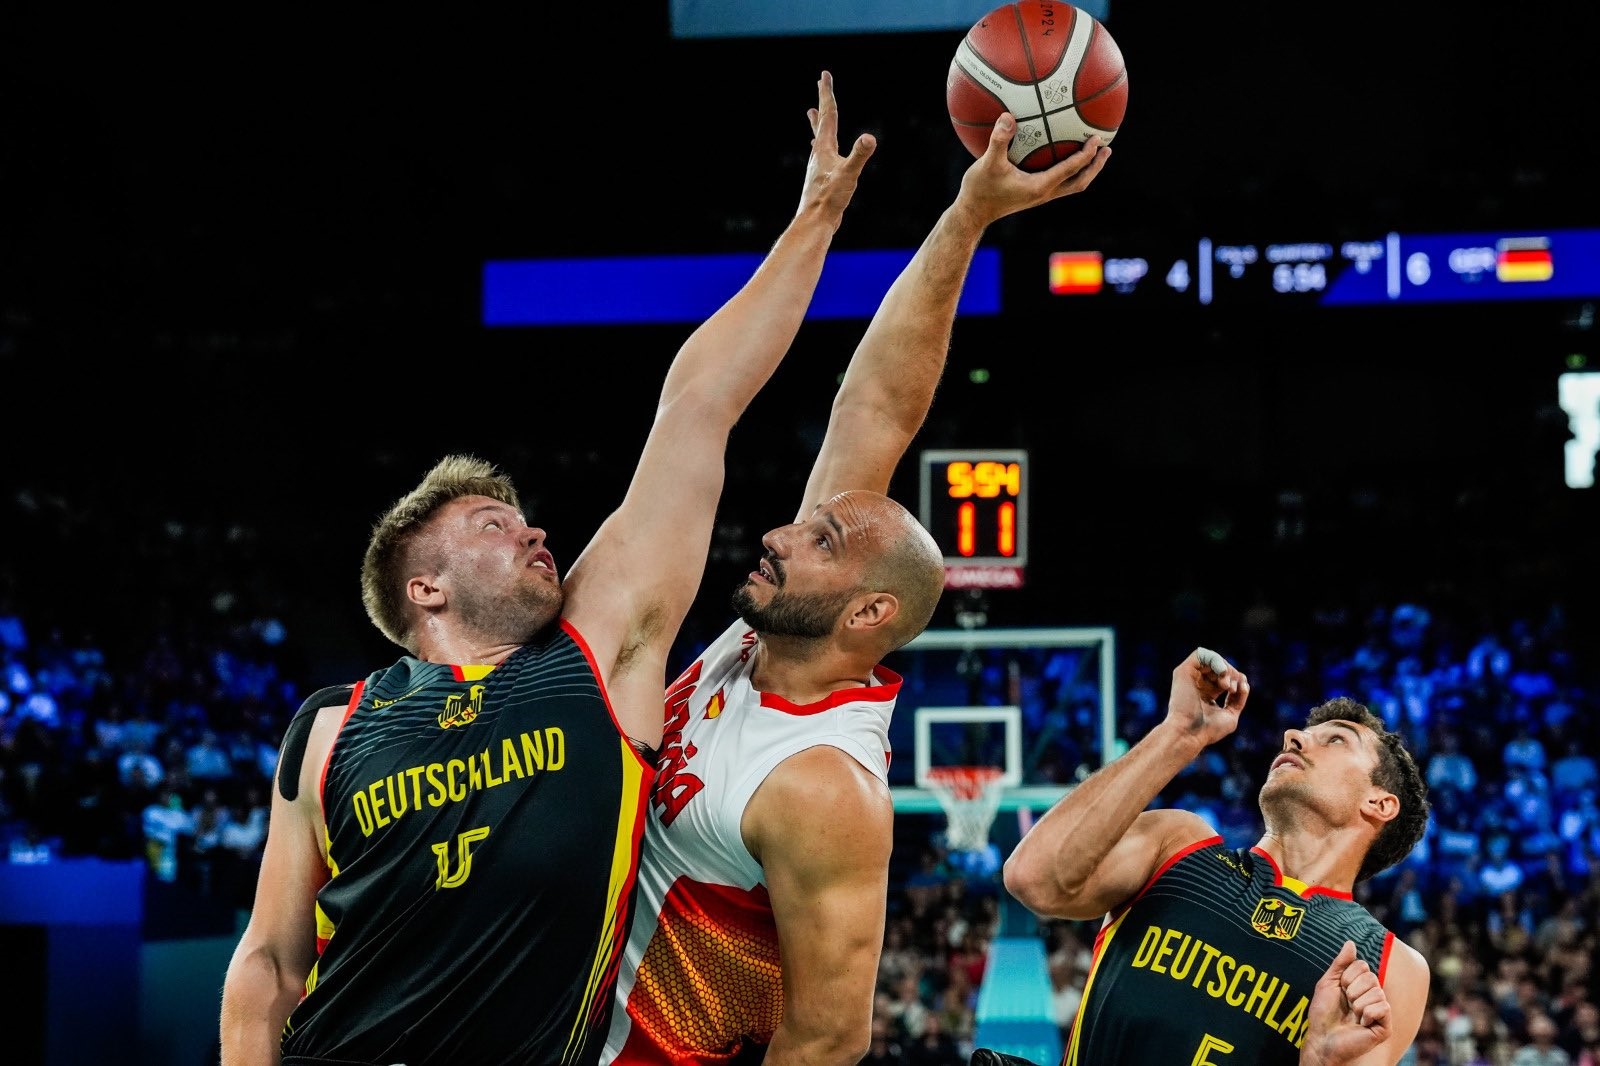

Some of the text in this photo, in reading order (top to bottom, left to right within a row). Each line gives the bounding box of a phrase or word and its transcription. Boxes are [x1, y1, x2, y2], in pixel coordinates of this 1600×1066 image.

[1165, 259, 1191, 293] 4
[352, 726, 566, 838] DEUTSCHLAND
[1131, 925, 1310, 1050] DEUTSCHLA
